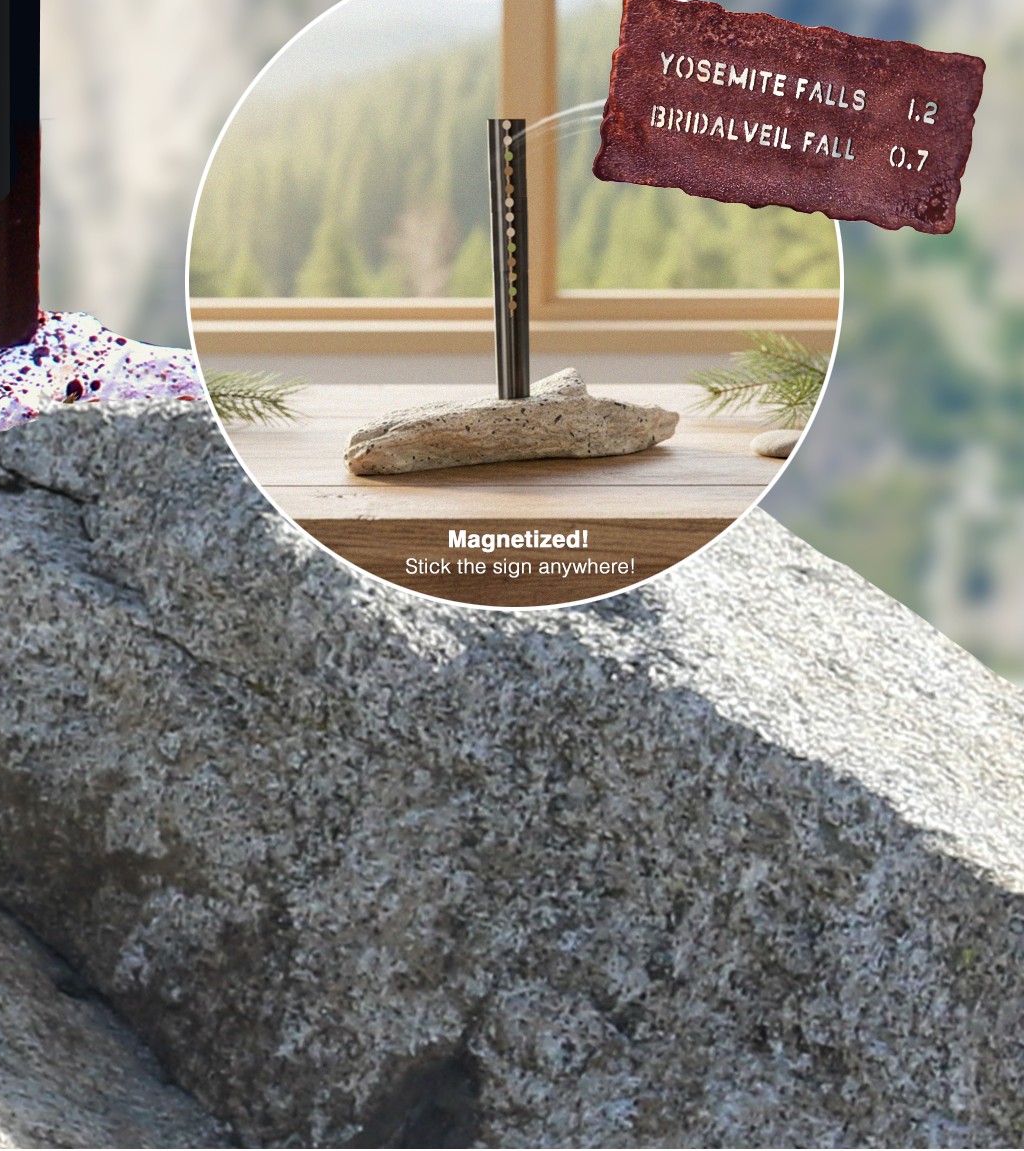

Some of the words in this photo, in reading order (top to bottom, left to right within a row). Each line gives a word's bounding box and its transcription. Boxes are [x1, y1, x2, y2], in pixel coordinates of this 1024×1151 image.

[660, 51, 788, 97] YOSEMITE
[795, 77, 867, 111] FALLS
[907, 98, 938, 125] 1.2
[650, 104, 791, 150] BRIDALVEIL
[802, 131, 855, 161] FALL
[889, 145, 929, 172] 0.7
